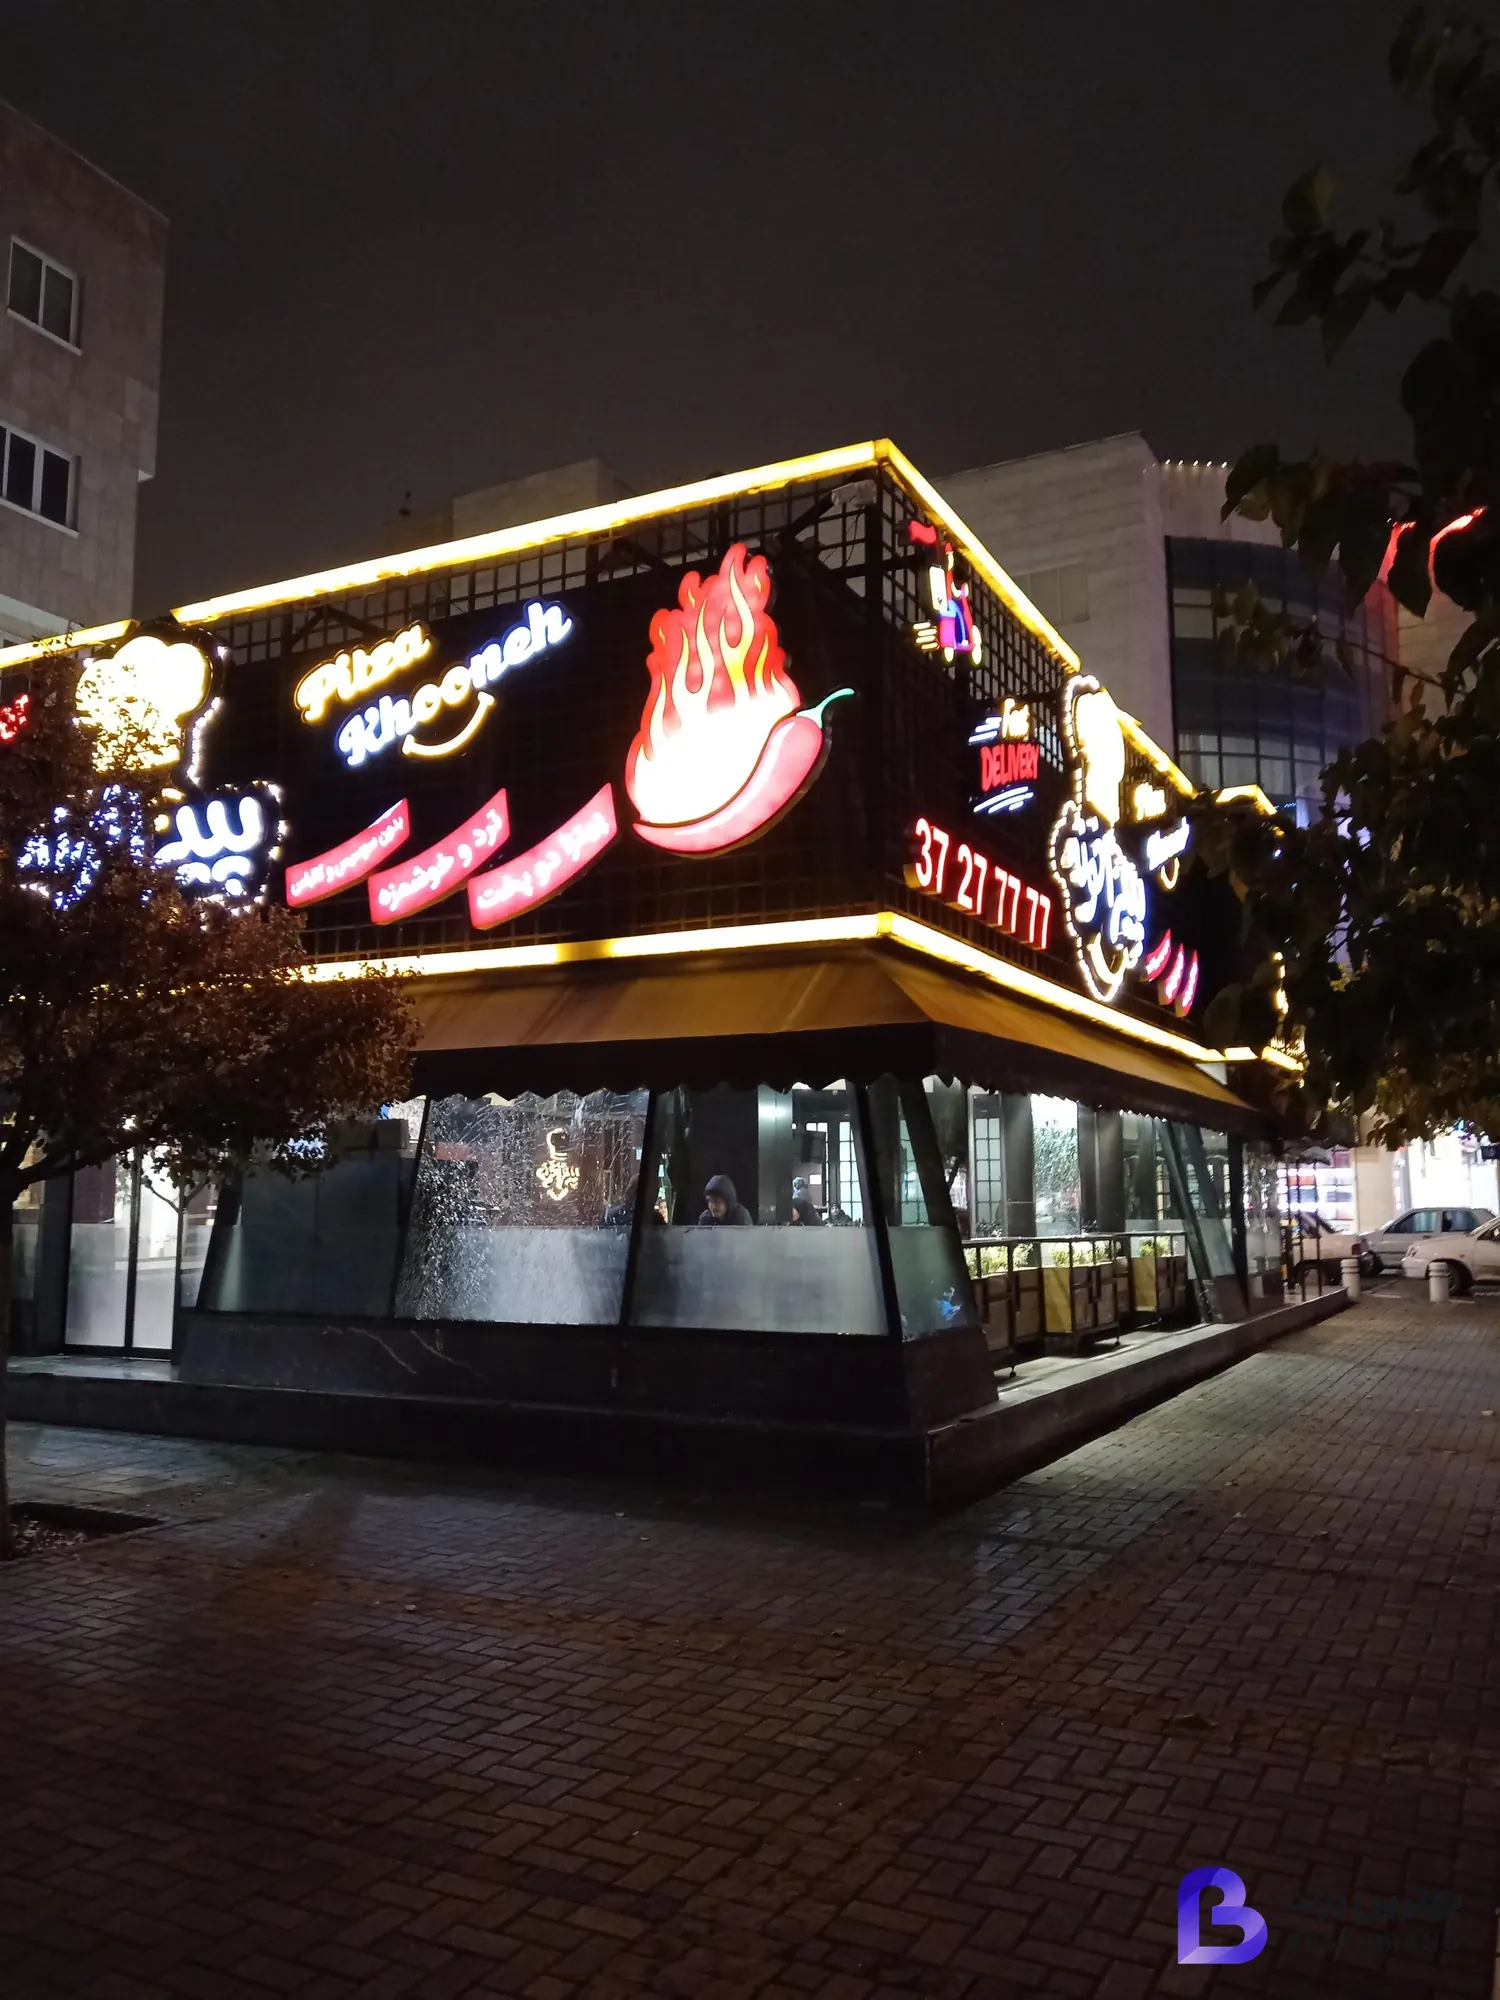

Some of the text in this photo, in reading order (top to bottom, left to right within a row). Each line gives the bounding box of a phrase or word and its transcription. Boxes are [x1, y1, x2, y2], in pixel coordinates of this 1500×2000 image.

[337, 600, 572, 766] Khooneh
[981, 743, 1039, 792] DELIVERY
[915, 818, 1051, 949] 37 27 77 77
